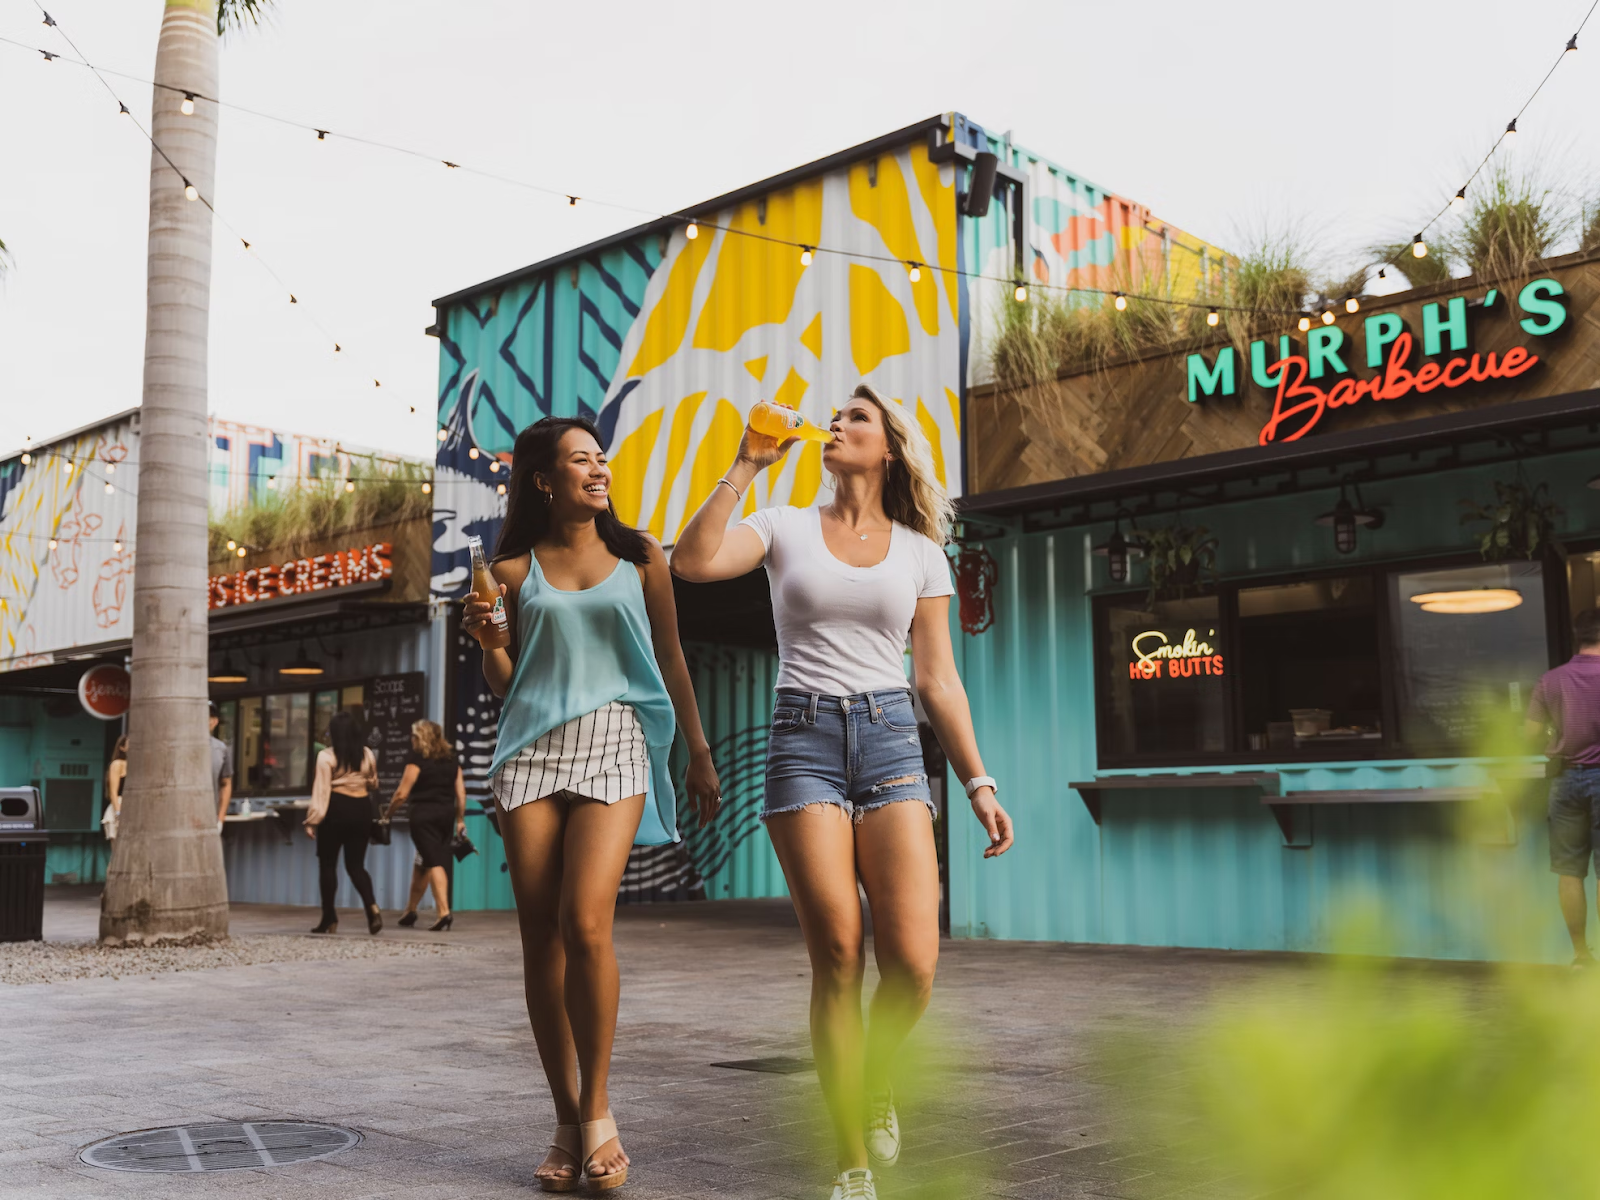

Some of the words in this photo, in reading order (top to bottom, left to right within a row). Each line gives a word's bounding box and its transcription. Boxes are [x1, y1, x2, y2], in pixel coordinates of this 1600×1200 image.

[1187, 278, 1567, 402] MURPH'S
[1258, 332, 1539, 446] Barbecue
[234, 564, 281, 605] ICE
[279, 542, 393, 595] CREAMS
[1129, 659, 1163, 680] HOT
[1168, 654, 1224, 679] BUTTS
[1132, 628, 1215, 673] Smokin'
